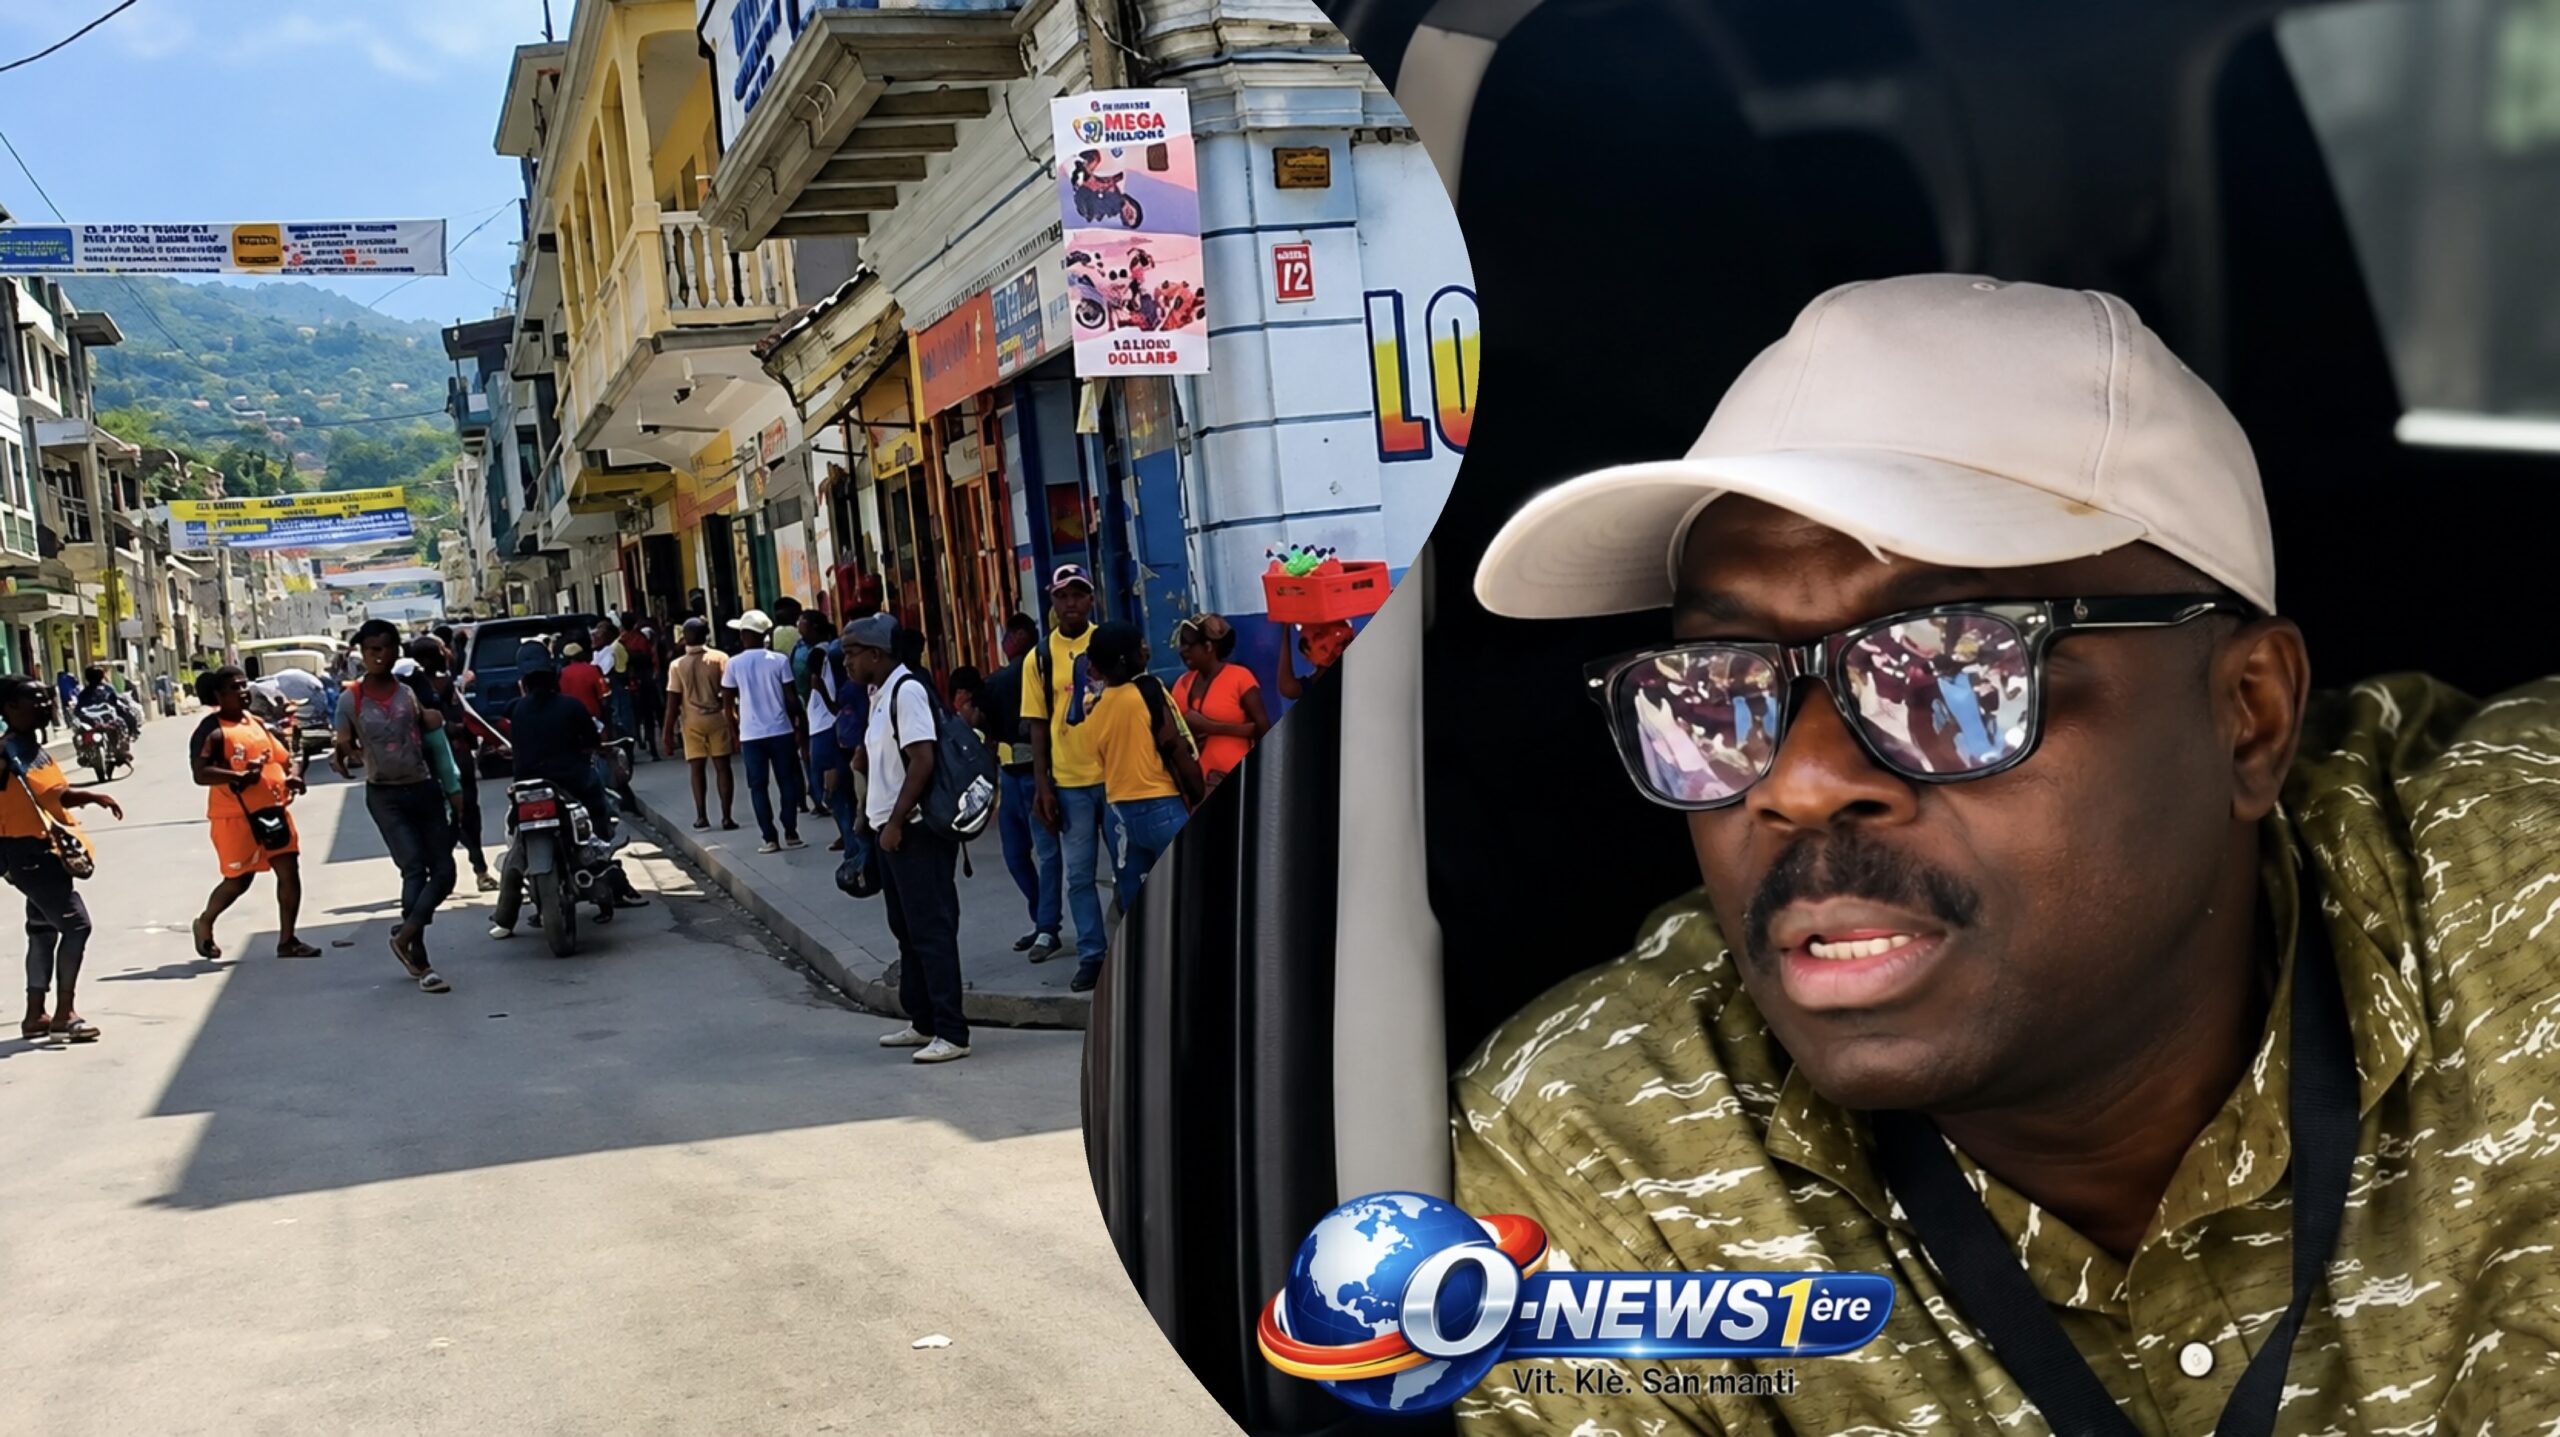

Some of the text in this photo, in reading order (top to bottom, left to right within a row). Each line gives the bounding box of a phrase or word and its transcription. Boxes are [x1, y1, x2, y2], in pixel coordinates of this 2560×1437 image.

[1104, 112, 1166, 131] MEGA
[1283, 262, 1309, 291] 12
[1108, 351, 1178, 365] DOLLARS
